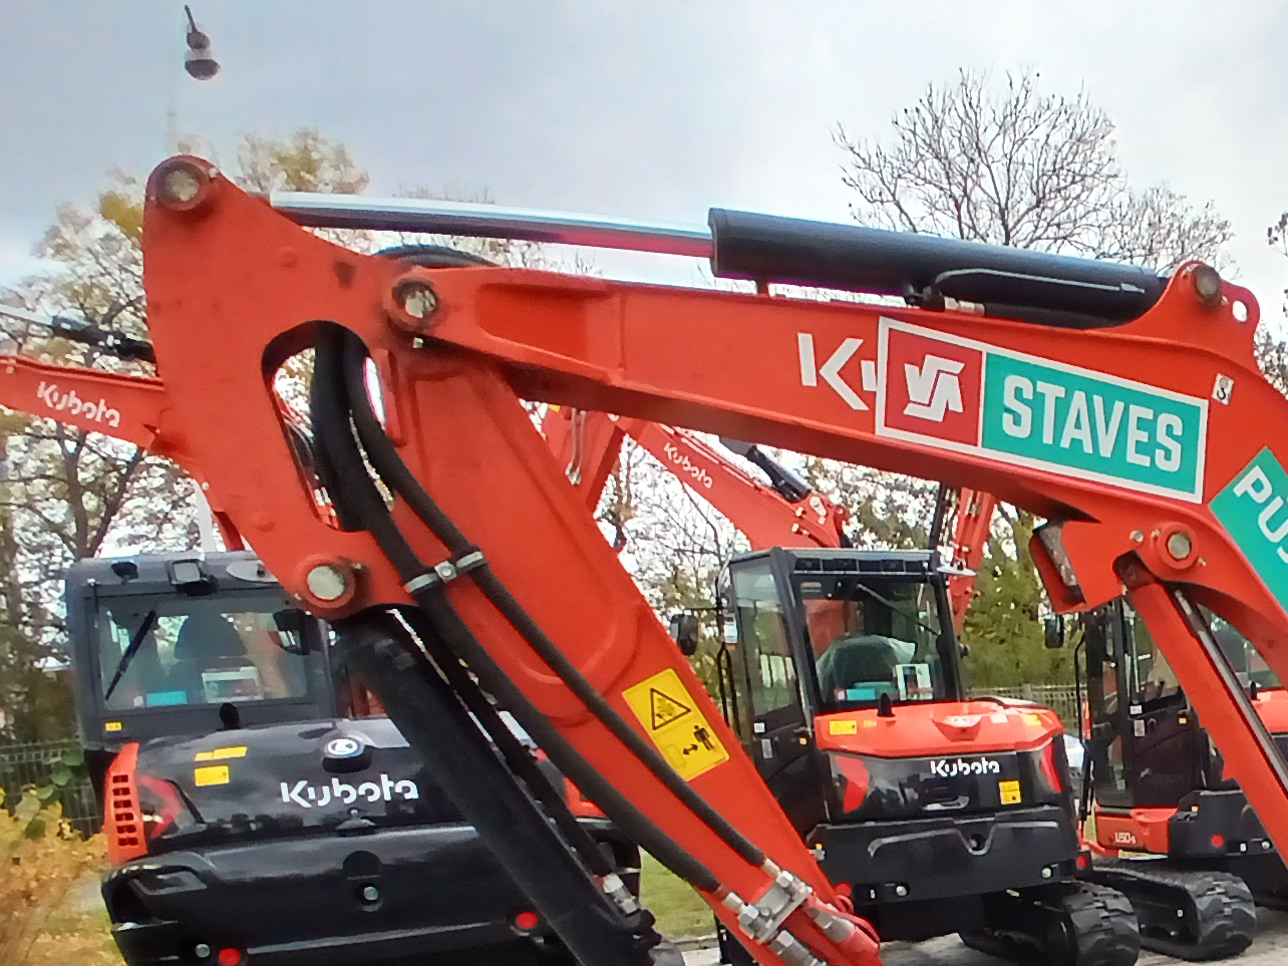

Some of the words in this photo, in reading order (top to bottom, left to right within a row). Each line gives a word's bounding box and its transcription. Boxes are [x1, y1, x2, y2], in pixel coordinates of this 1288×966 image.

[37, 381, 120, 428] Kubota
[1002, 375, 1183, 473] STAVES
[663, 442, 713, 489] Kubota
[280, 773, 419, 808] Kubota
[930, 757, 1000, 777] Kubota
